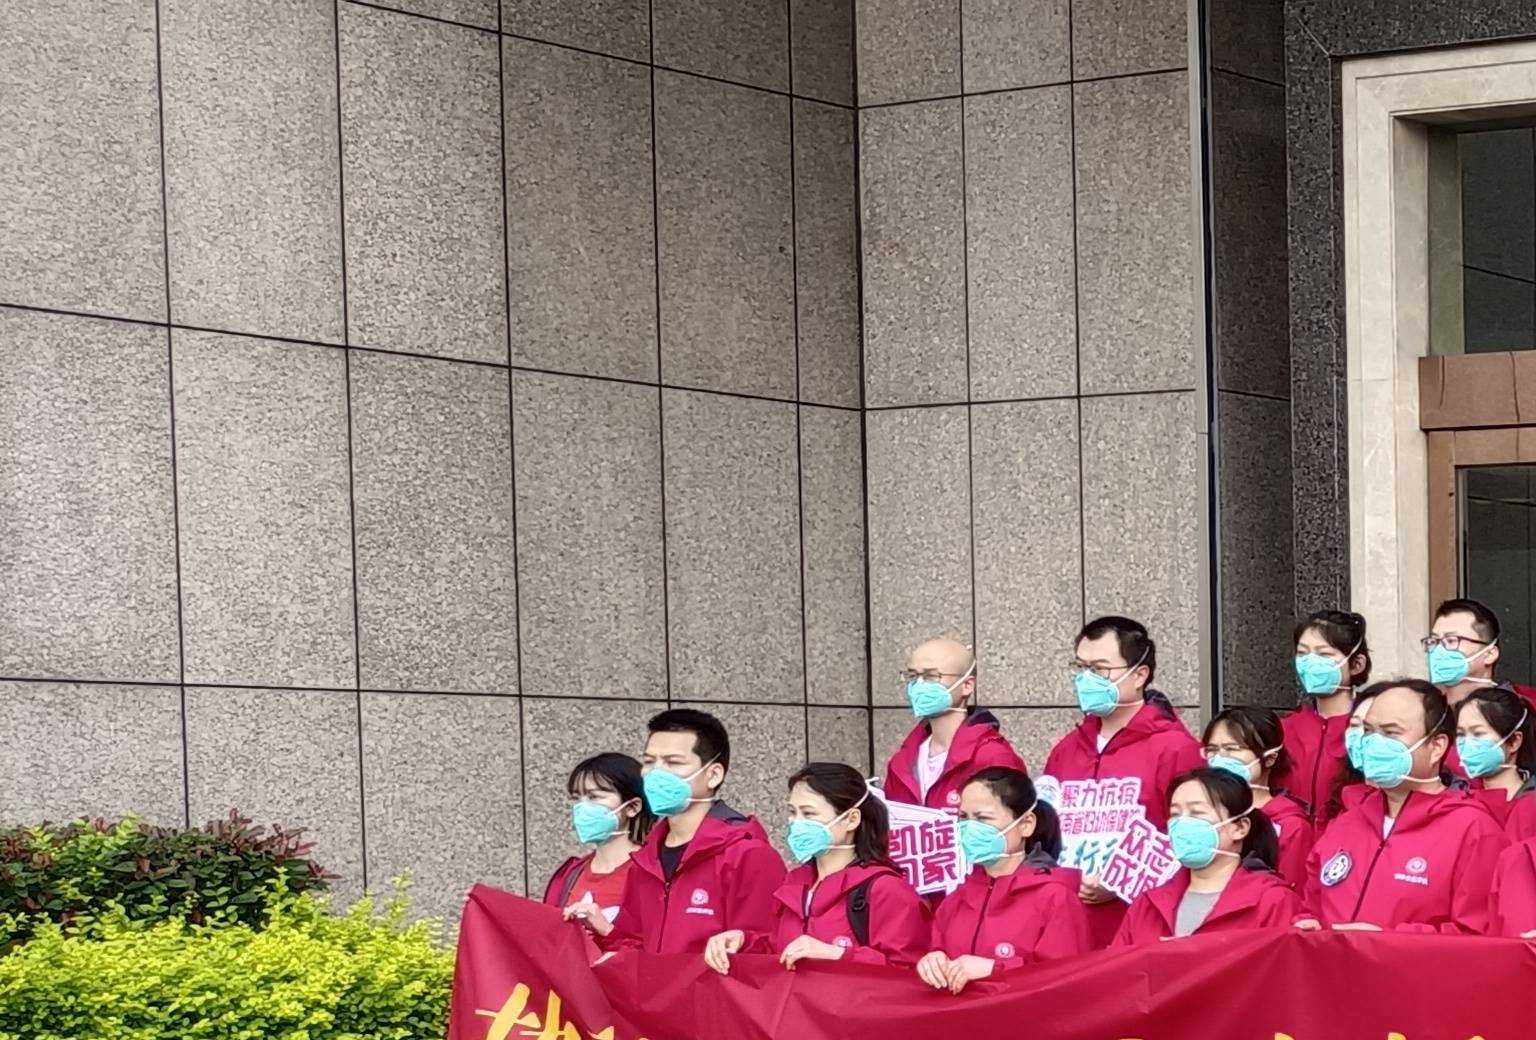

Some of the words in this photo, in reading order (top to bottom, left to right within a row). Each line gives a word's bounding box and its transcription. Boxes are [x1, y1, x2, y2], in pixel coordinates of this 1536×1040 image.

[1061, 781, 1138, 808] 聚力抗疫
[889, 819, 956, 860] 凯旋
